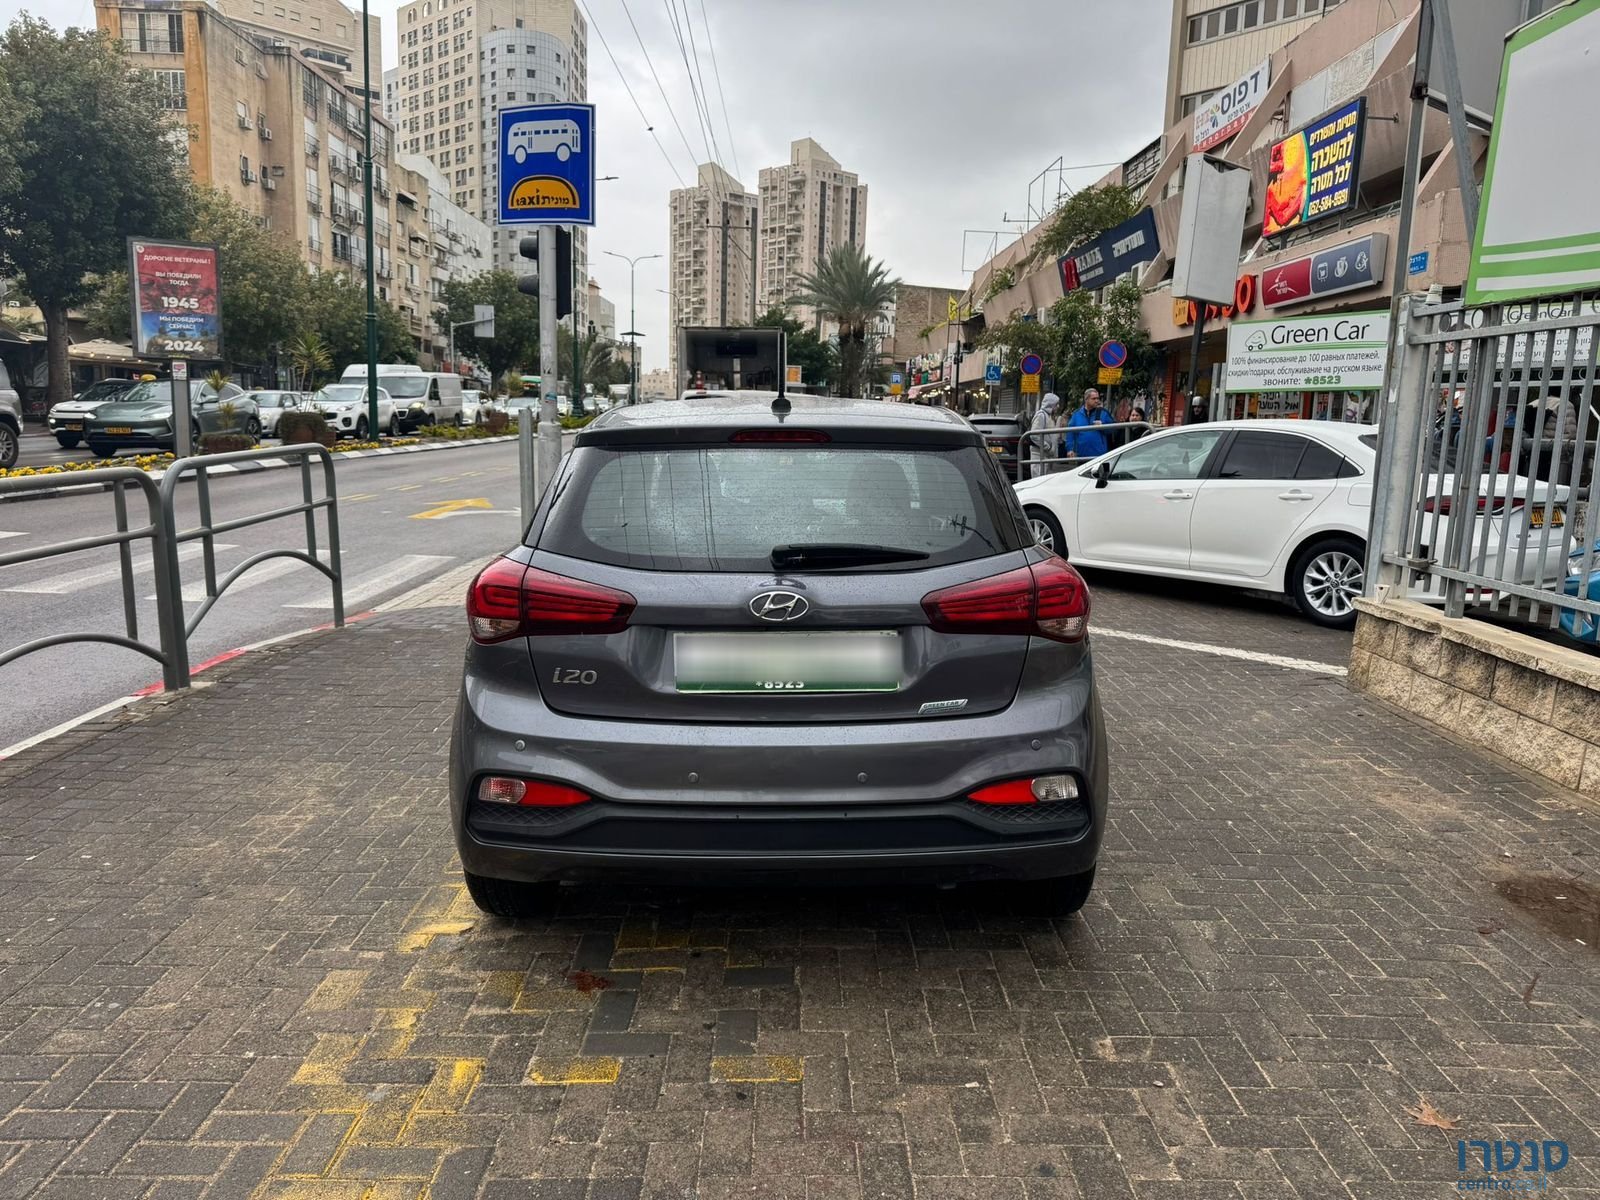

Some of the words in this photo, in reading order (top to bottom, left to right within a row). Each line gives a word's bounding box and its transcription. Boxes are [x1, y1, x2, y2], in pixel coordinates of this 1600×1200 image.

[1221, 71, 1260, 115] דפוס
[1311, 131, 1354, 173] להשכרה
[1335, 160, 1351, 185] לכל
[1310, 170, 1333, 195] מטרה
[516, 188, 540, 206] taxi
[541, 194, 570, 205] מונית
[143, 254, 173, 262] ДОРОГИЕ
[161, 296, 200, 309] 1945
[1509, 310, 1547, 322] Gren
[1271, 324, 1328, 345] Green
[1334, 320, 1370, 341] Car
[165, 340, 205, 352] 2024
[1247, 356, 1298, 365] финансирование
[1298, 355, 1307, 363] до
[1309, 353, 1320, 362] 100
[1321, 353, 1345, 363] равных
[1276, 366, 1322, 377] обслуживание
[1333, 365, 1360, 374] русском
[1263, 378, 1301, 386] звоните:
[1285, 401, 1299, 410] מול
[552, 667, 598, 685] i20
